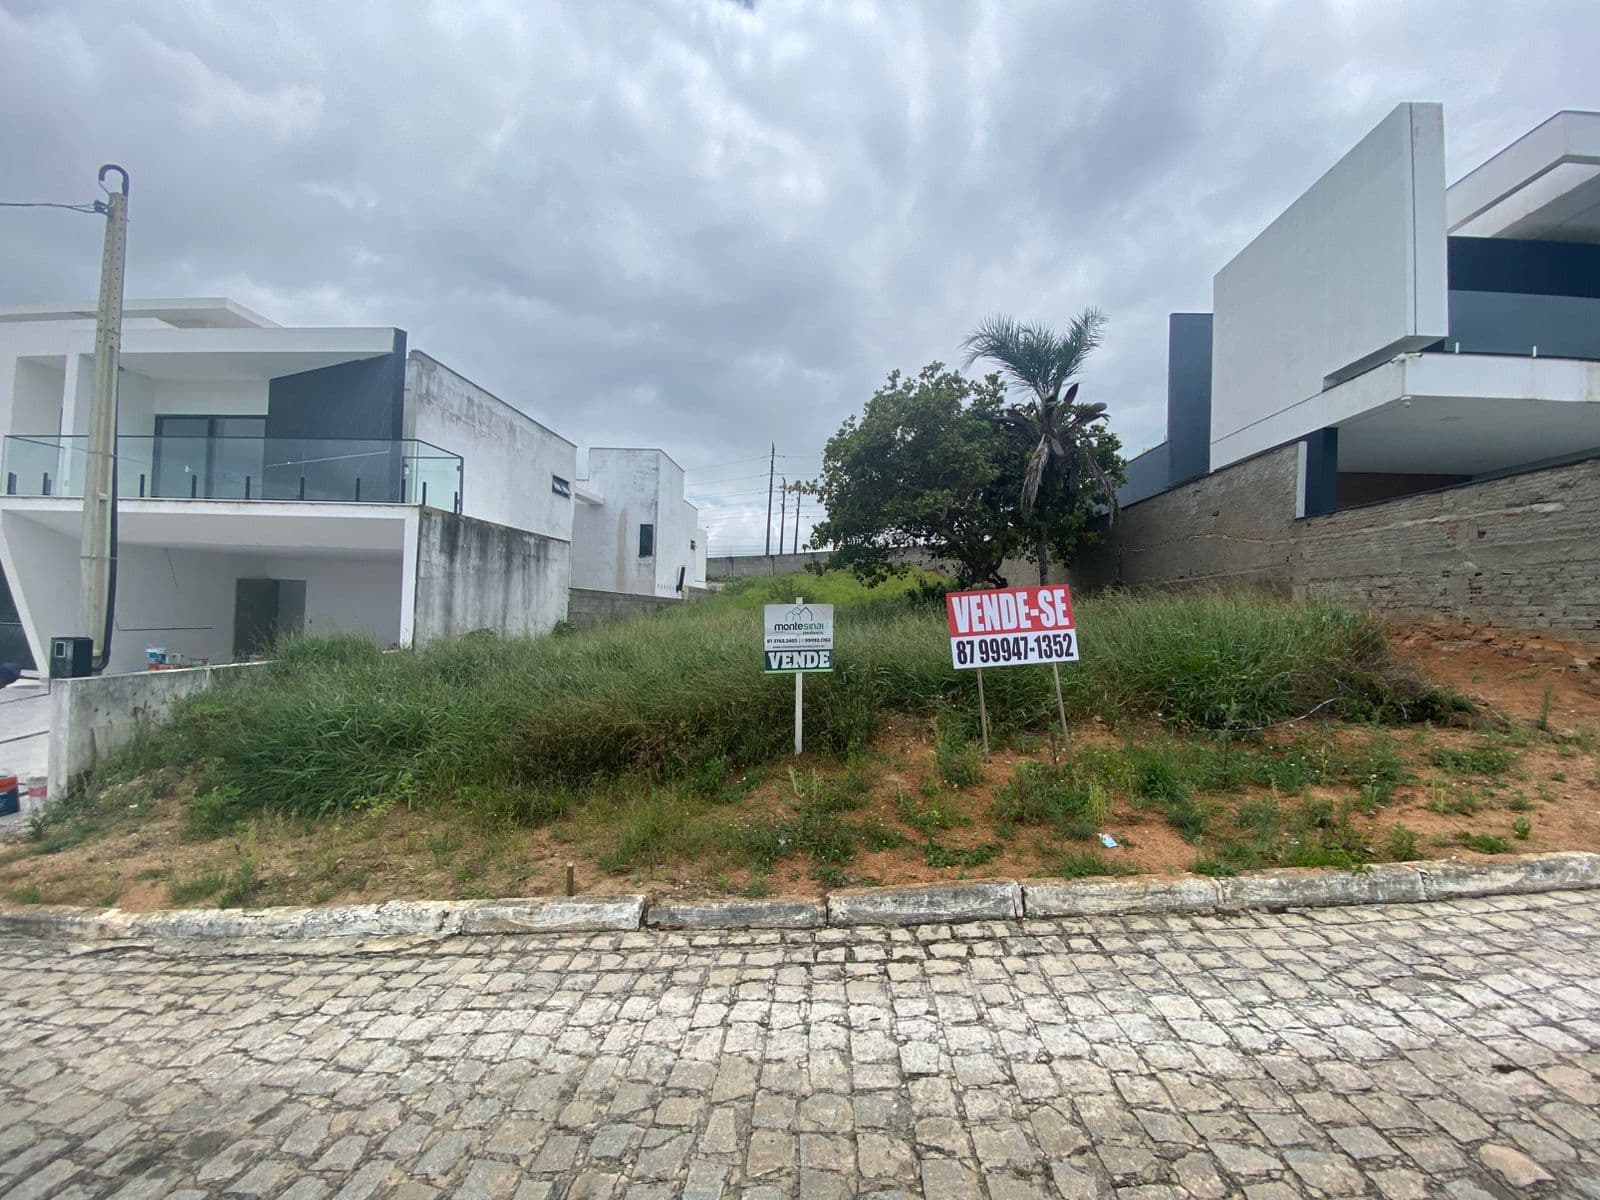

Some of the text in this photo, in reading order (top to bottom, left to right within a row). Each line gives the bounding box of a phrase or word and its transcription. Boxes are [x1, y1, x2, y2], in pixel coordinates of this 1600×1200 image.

[951, 589, 1070, 633] VENDE-SE
[774, 622, 824, 631] montesinai
[768, 651, 830, 669] VENDE
[956, 633, 1074, 665] 87 99947-1352
